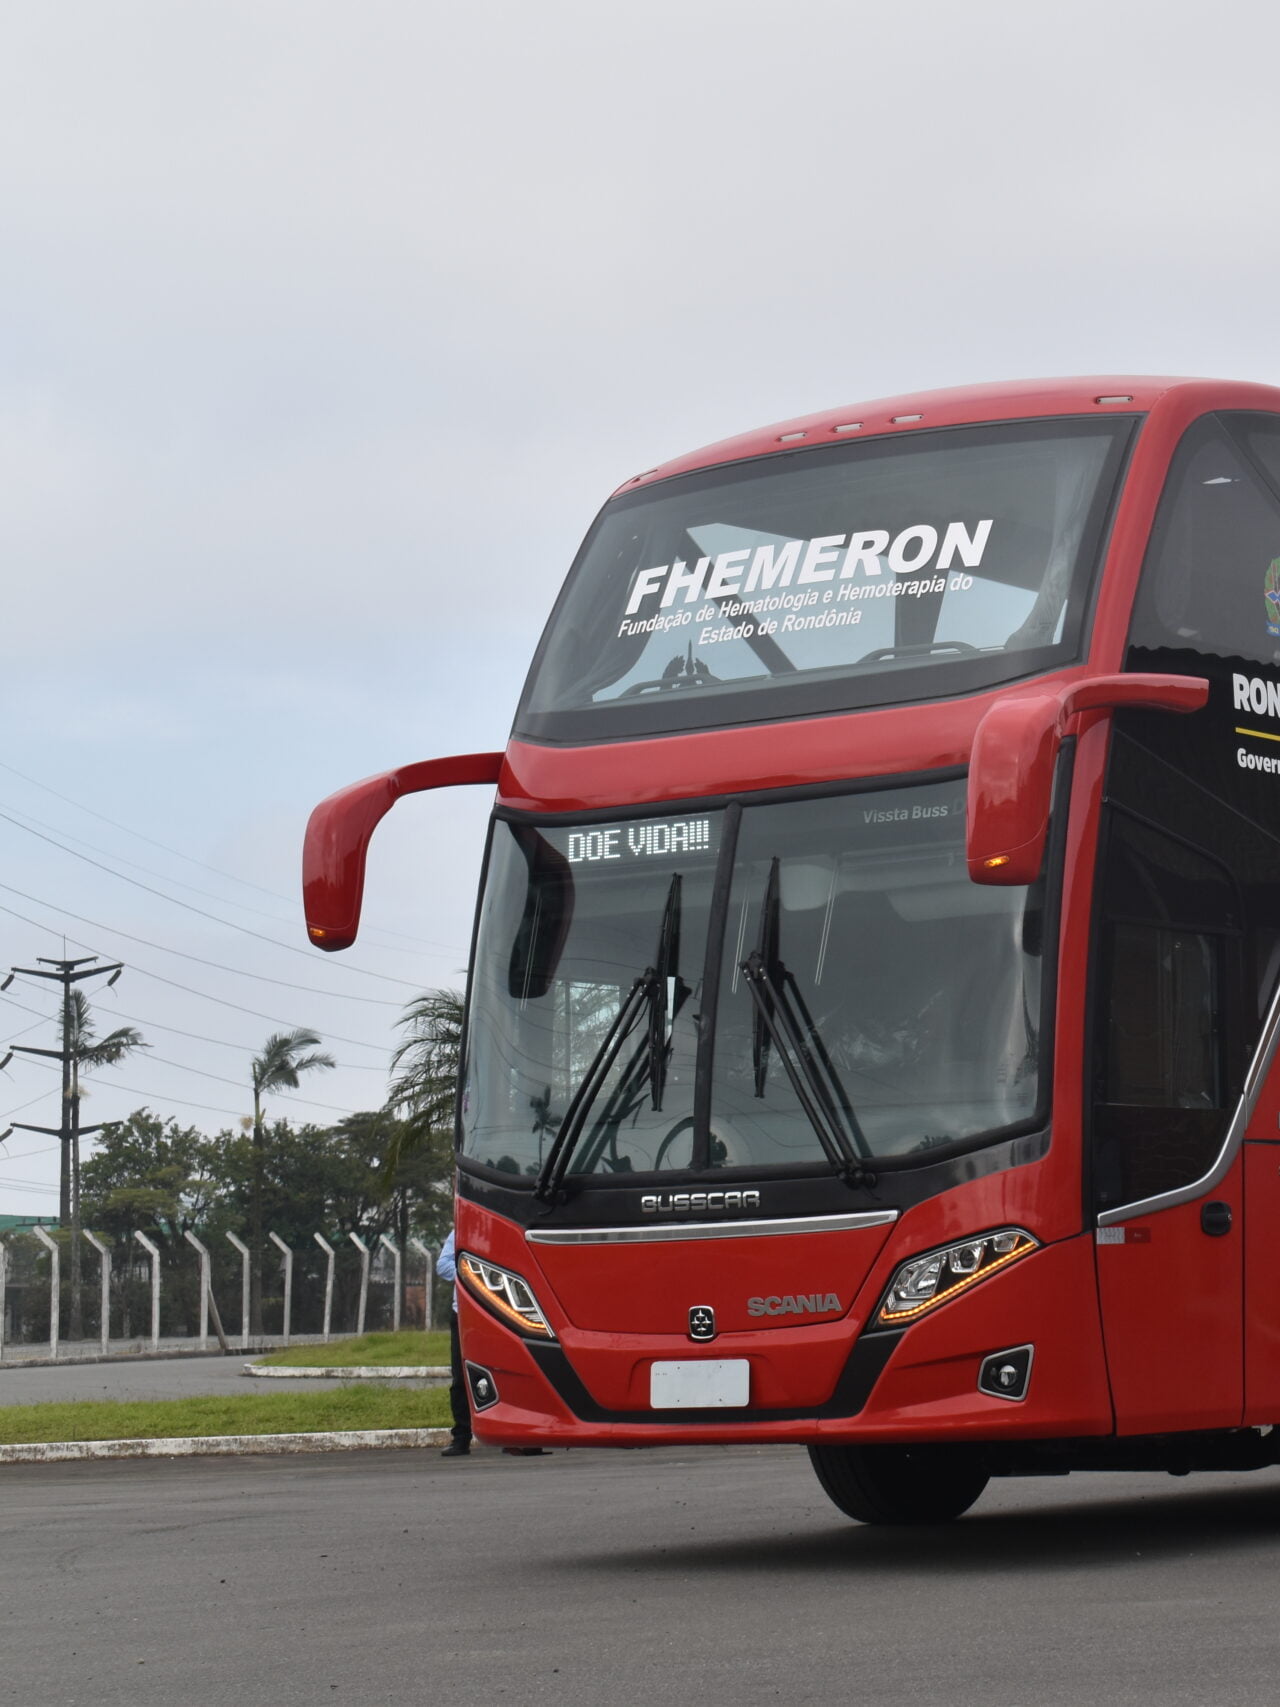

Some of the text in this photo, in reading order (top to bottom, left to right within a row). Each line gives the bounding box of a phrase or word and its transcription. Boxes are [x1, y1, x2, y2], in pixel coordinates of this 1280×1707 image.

[625, 519, 993, 615] FHEMERON
[617, 573, 973, 638] Fundação de Hematologia e Hemoterapia do
[698, 608, 862, 645] Estado de Rondônia
[863, 807, 909, 824] Vissta
[911, 805, 949, 819] Buss
[568, 820, 709, 863] DOE VIDA!!!
[641, 1190, 760, 1213] BUSSCAR
[747, 1293, 842, 1317] SCANIA
